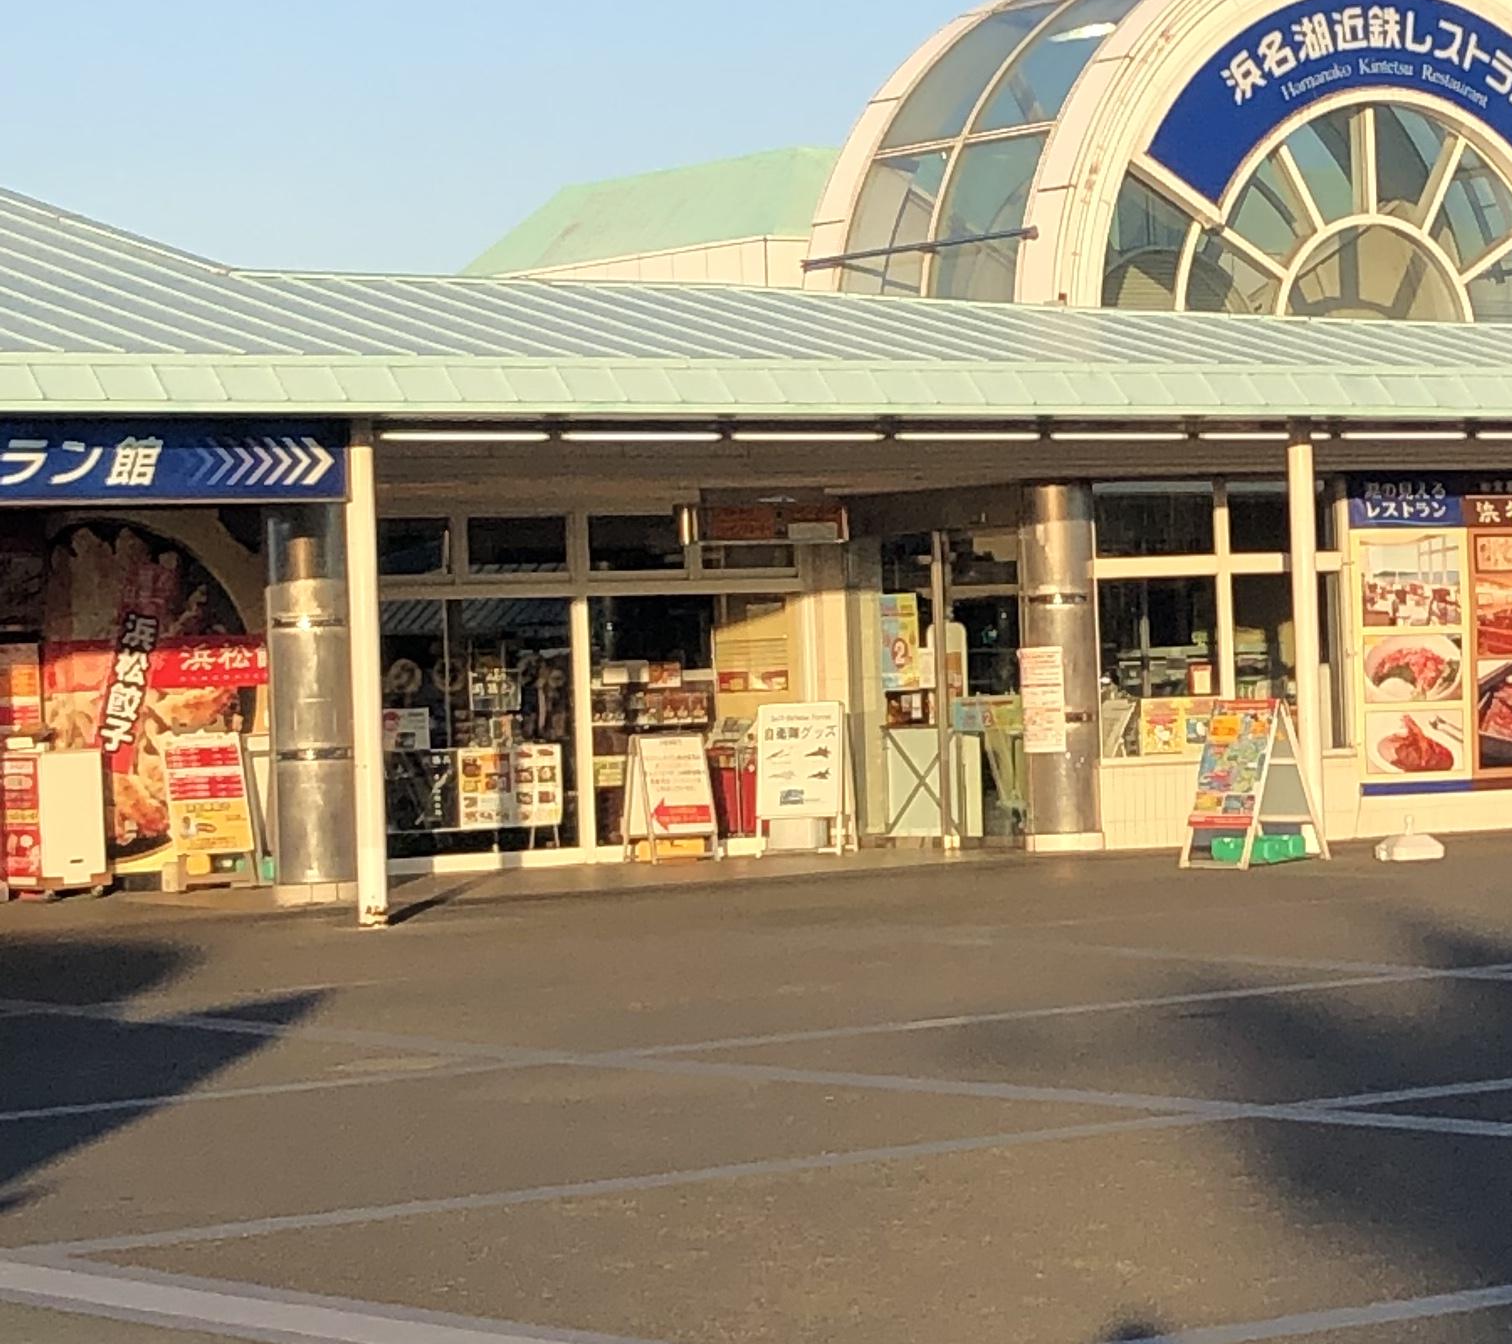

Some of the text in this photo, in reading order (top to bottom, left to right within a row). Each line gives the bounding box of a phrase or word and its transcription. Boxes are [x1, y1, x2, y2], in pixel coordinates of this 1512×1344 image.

[1280, 58, 1488, 110] Hamanako Kintetsu Restaurant
[1366, 501, 1447, 519] レストラン
[101, 613, 158, 753] 浜松餃子
